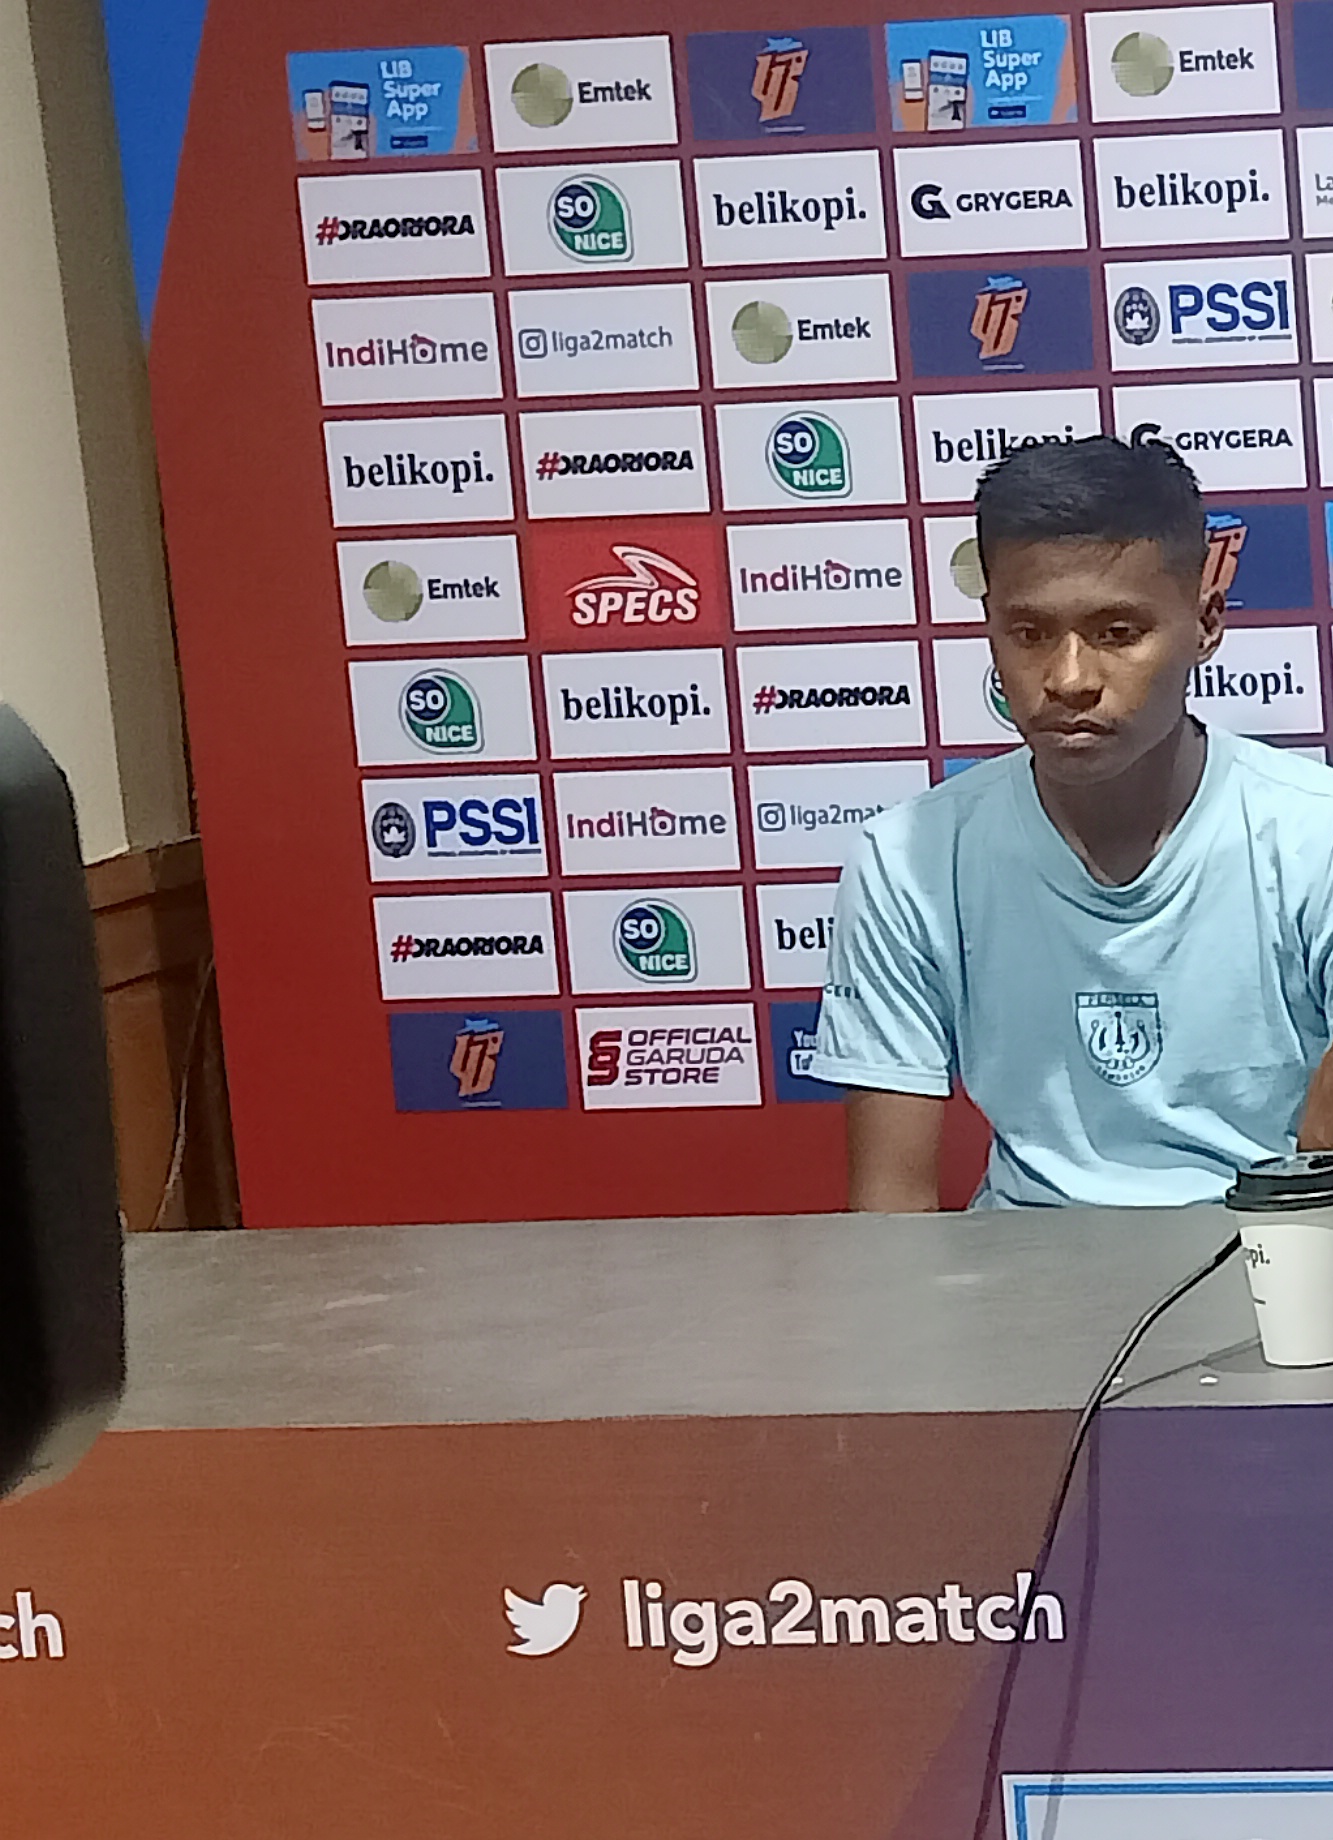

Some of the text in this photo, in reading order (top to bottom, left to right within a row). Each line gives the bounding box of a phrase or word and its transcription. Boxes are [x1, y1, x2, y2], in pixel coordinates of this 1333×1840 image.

[980, 29, 1012, 47] LIB
[381, 60, 412, 78] LIB
[984, 50, 1041, 71] Super
[1179, 47, 1254, 72] Emtek
[384, 81, 441, 101] Super
[578, 79, 652, 103] Emtek
[986, 70, 1027, 91] App
[387, 100, 428, 121] App
[957, 189, 1073, 212] GRYGERA
[1114, 169, 1269, 213] belikopi.
[558, 196, 593, 217] SO
[713, 187, 866, 230] belikopi.
[575, 232, 623, 250] NICE
[1168, 280, 1289, 334] PSSI
[798, 317, 871, 340] Emtek
[326, 334, 488, 368] IndiHome
[552, 326, 672, 357] liga2match
[777, 432, 812, 453] SO
[1175, 429, 1293, 450] GRYGERA
[344, 451, 493, 493] belikopi.
[793, 468, 842, 485] NICE
[740, 560, 902, 593] IndiHome
[428, 576, 500, 599] Emtek
[572, 591, 698, 625] SPECS
[410, 690, 444, 710] SO
[561, 684, 710, 725] belikopi.
[426, 725, 474, 742] NICE
[423, 797, 539, 848] PSSI
[567, 807, 726, 838] IndiHome
[624, 919, 658, 939] SO
[639, 954, 688, 970] NICE
[628, 1027, 752, 1046] OFFICIAL
[627, 1047, 744, 1066] GARUDA
[624, 1067, 720, 1086] STORE
[620, 1573, 1068, 1668] liga2match
